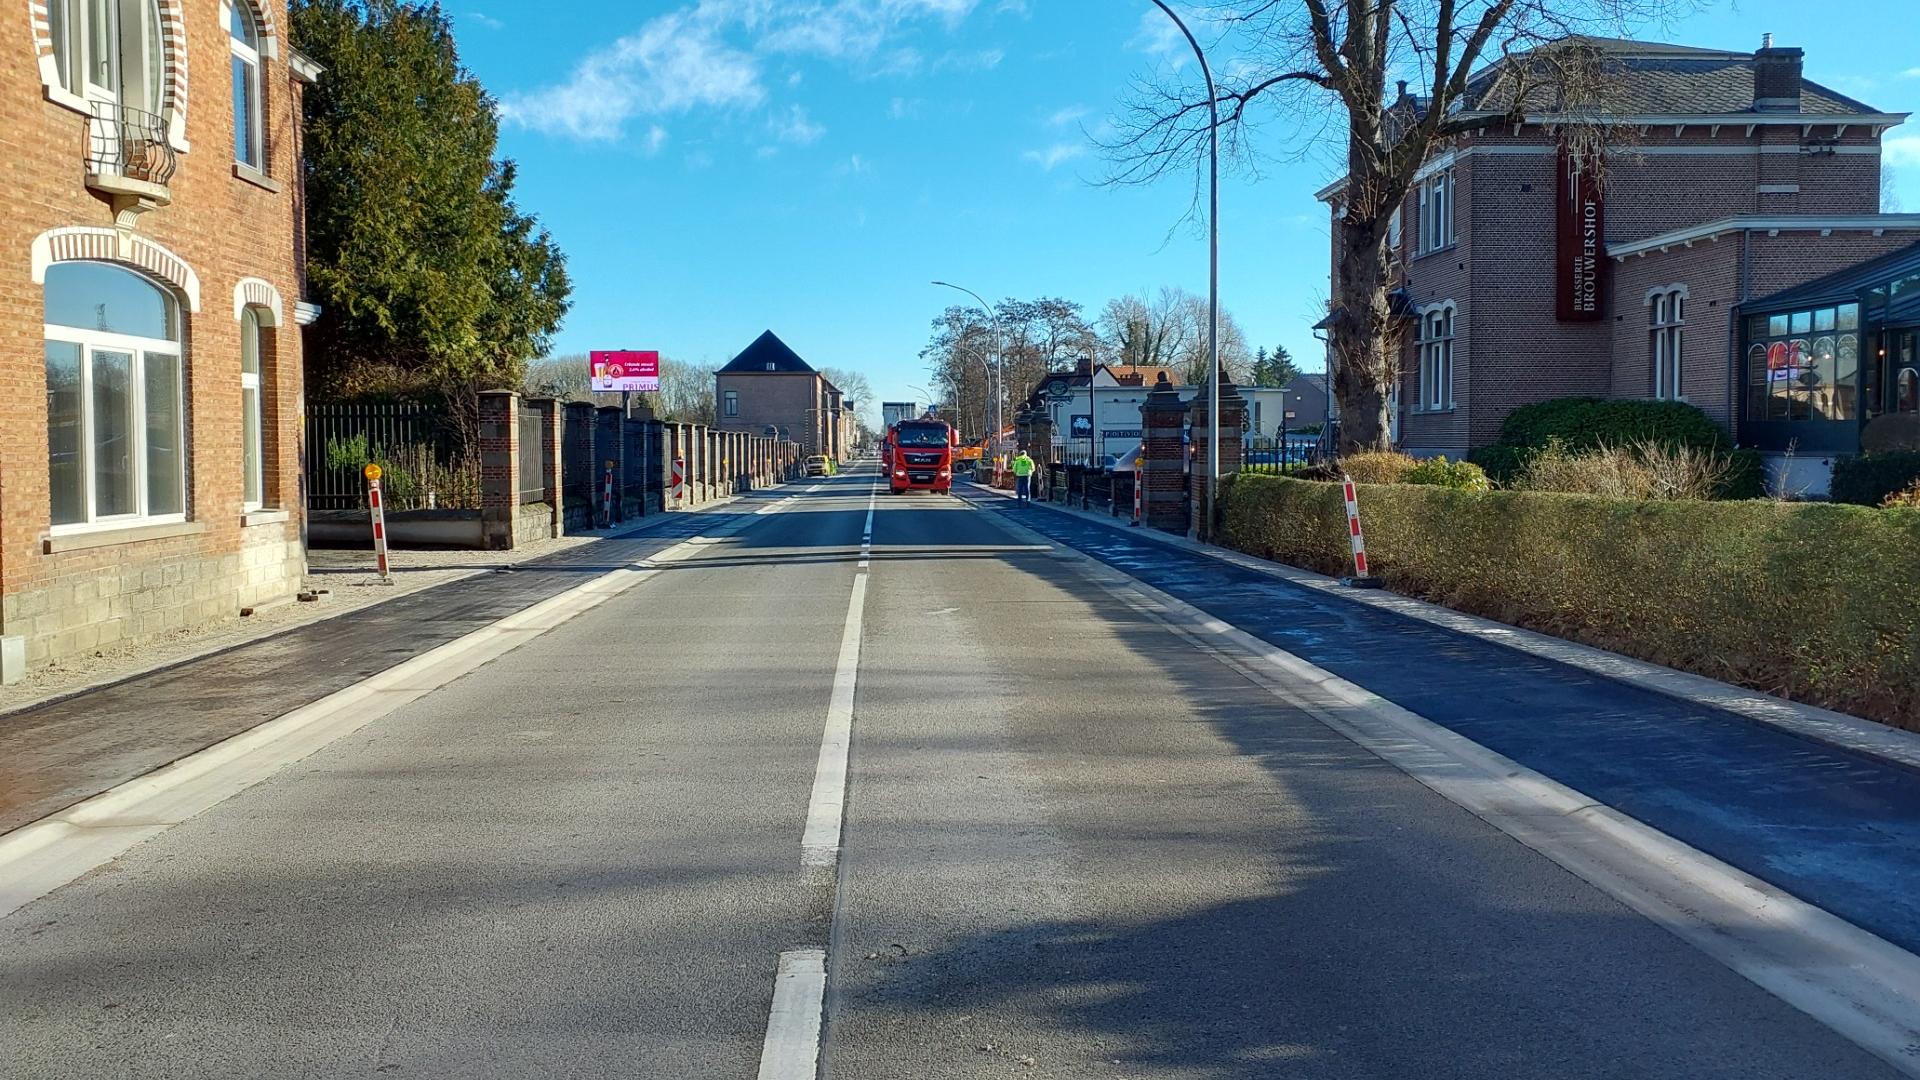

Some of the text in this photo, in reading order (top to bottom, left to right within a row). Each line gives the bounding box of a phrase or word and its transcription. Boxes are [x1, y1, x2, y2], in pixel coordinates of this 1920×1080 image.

[1584, 199, 1596, 312] BROUWERSHOF
[1574, 256, 1582, 311] BRASSERIE
[623, 383, 659, 391] PRIMUS
